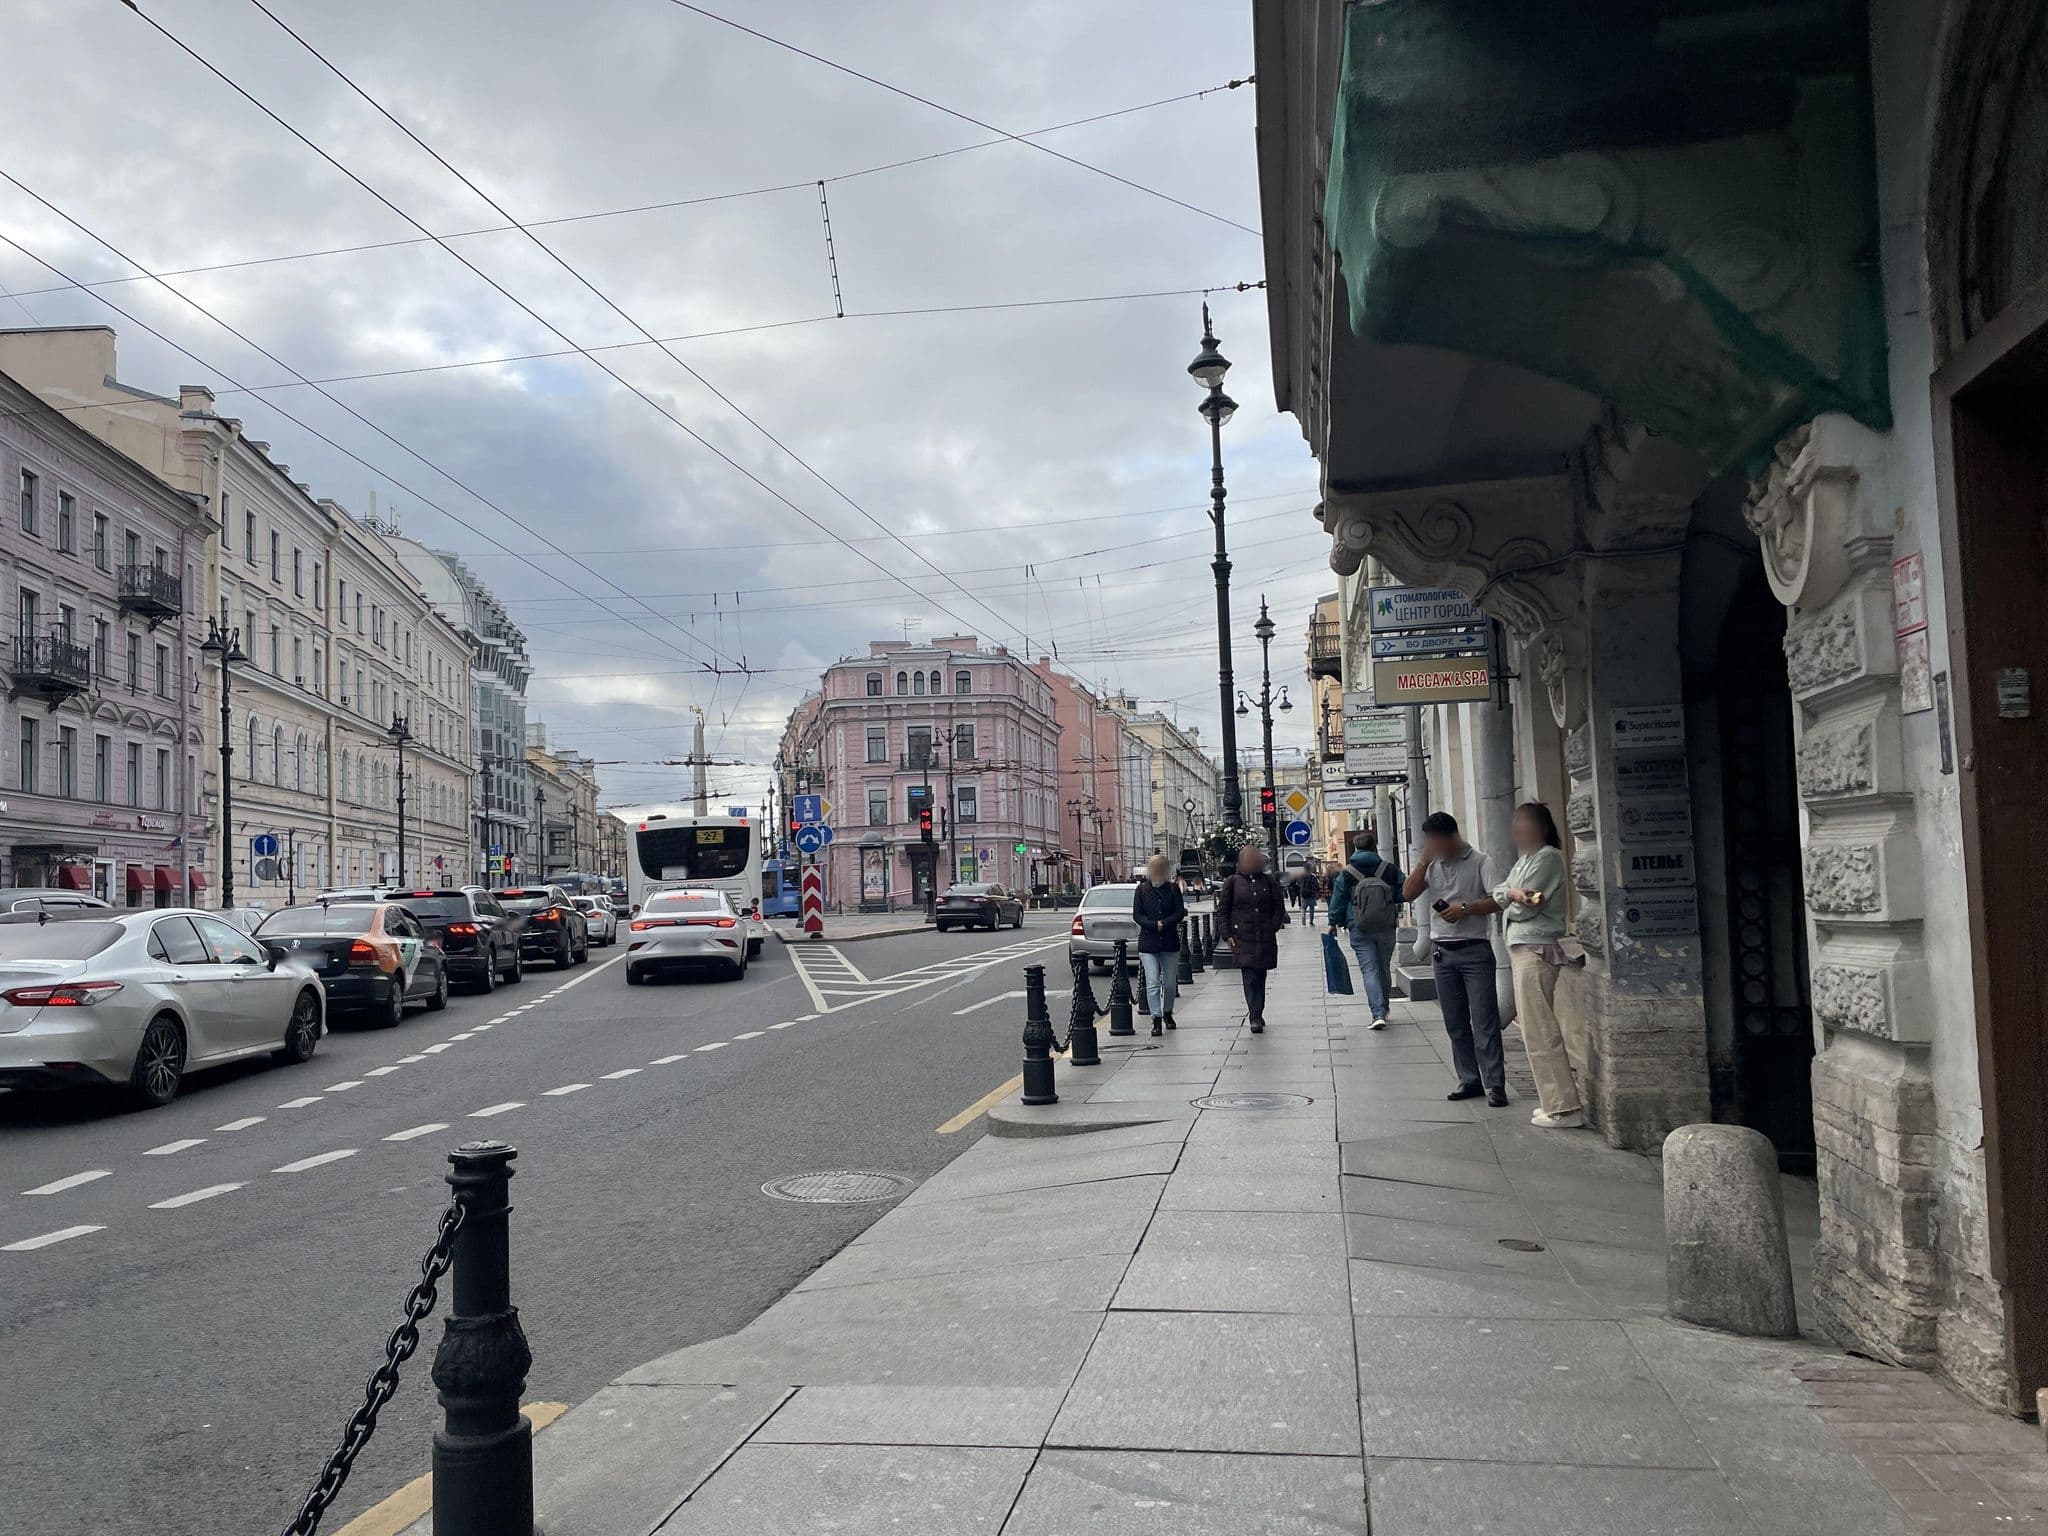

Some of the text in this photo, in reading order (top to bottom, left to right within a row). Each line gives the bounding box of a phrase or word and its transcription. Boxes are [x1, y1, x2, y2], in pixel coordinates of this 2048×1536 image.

[1394, 589, 1465, 604] СТОМАТОЛОГИЧЕС
[1395, 603, 1477, 623] ЦЕНТР ГОРОДА
[1406, 637, 1455, 649] ВО ДВОРЕ
[1397, 670, 1488, 690] МАССАЖ & SPA
[1629, 721, 1649, 731] Super
[704, 831, 717, 840] 27
[1632, 855, 1684, 870] АТЕЛЬЕ
